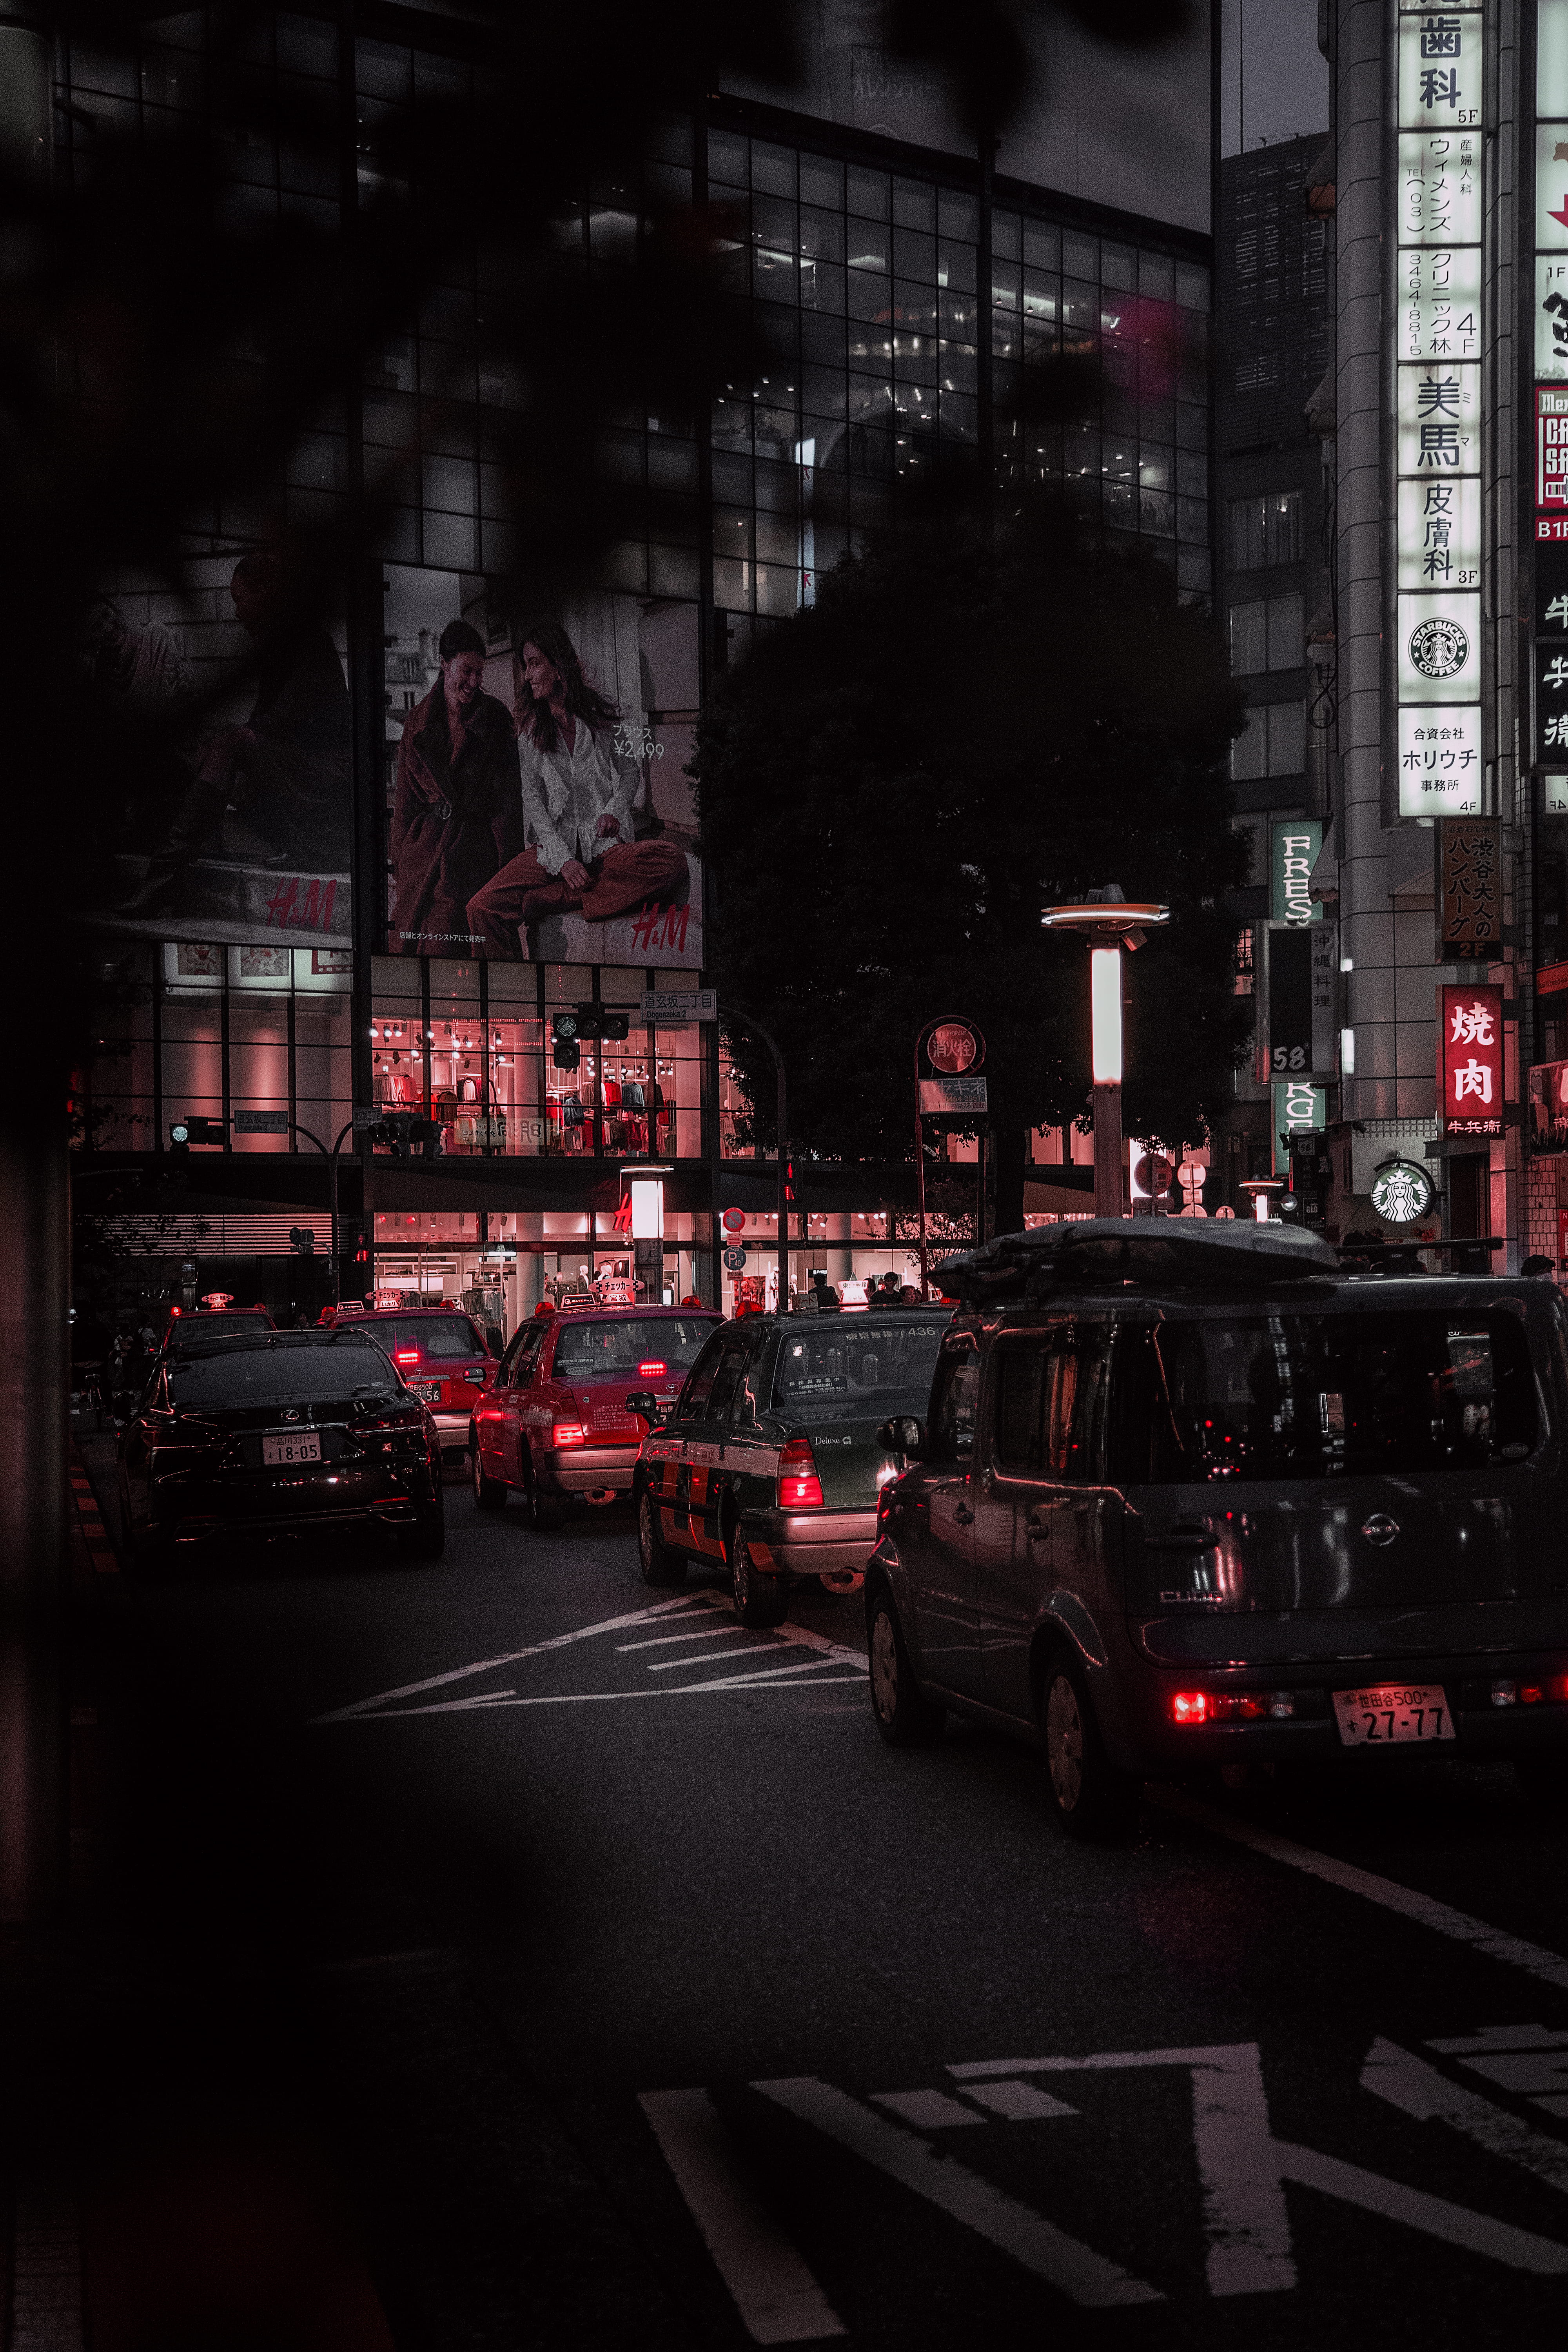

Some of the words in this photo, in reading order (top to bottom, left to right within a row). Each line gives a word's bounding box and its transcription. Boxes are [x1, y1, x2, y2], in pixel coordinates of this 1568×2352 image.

[1420, 16, 1462, 109] 歯科
[1458, 109, 1478, 123] 5F
[1460, 139, 1472, 195] 産婦人科
[1548, 267, 1566, 278] 1F
[1409, 254, 1422, 356] 3464-8815
[1417, 376, 1460, 466] 美馬
[1423, 484, 1454, 581] 皮膚科
[1458, 571, 1477, 583] 3F
[1412, 621, 1466, 647] STARBUCKS
[1418, 660, 1460, 676] COFFEE
[1414, 728, 1465, 740] 合資会社
[613, 739, 665, 760] ¥2,499
[1403, 749, 1477, 770] ホリウチ
[1421, 780, 1459, 792] 事務所
[1460, 801, 1476, 811] 4F
[1448, 838, 1471, 937] ハンバーグ
[1471, 837, 1495, 937] 渋谷大人の
[265, 877, 337, 933] H&M
[631, 902, 690, 953] H&M
[1459, 942, 1485, 957] 2F
[644, 994, 712, 1009] 道玄坂二丁目
[647, 1010, 681, 1018] Dogenzaka
[932, 1039, 972, 1058] 消火栓
[1450, 1002, 1494, 1104] 焼肉
[1273, 1046, 1305, 1070] 58
[237, 1113, 285, 1124] 道玄坂二丁目
[1448, 1120, 1502, 1133] 牛兵衛
[728, 1252, 737, 1267] P
[605, 1281, 630, 1290] チェッカー
[276, 1436, 305, 1446] 品川331
[814, 1436, 840, 1445] Deluxe
[278, 1445, 317, 1461] 18-05
[1359, 1690, 1423, 1708] 世田谷500
[1362, 1708, 1443, 1739] 27-77
